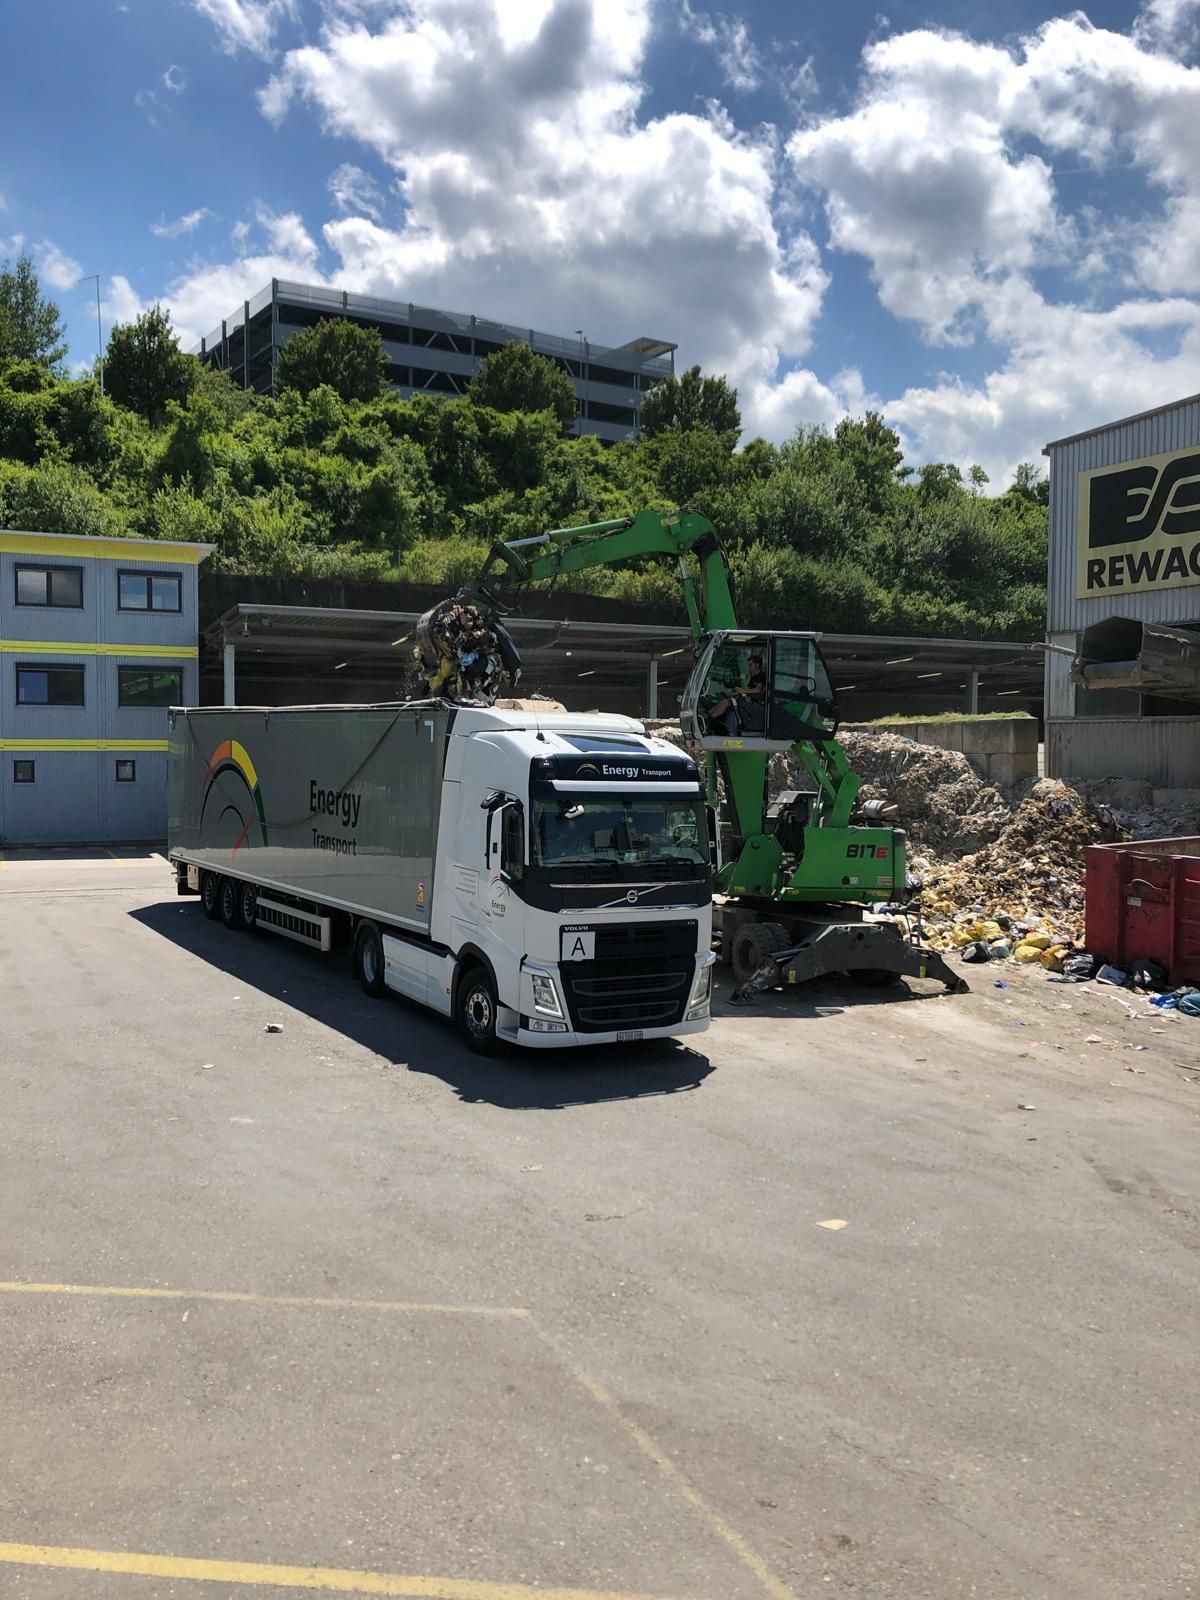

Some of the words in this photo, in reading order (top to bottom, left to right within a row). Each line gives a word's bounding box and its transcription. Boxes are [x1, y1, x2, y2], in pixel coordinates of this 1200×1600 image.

[602, 764, 639, 778] Energy
[641, 768, 672, 777] Transport
[309, 780, 361, 828] Energy
[311, 828, 357, 857] Transport
[846, 844, 889, 859] 817E
[571, 936, 586, 957] A
